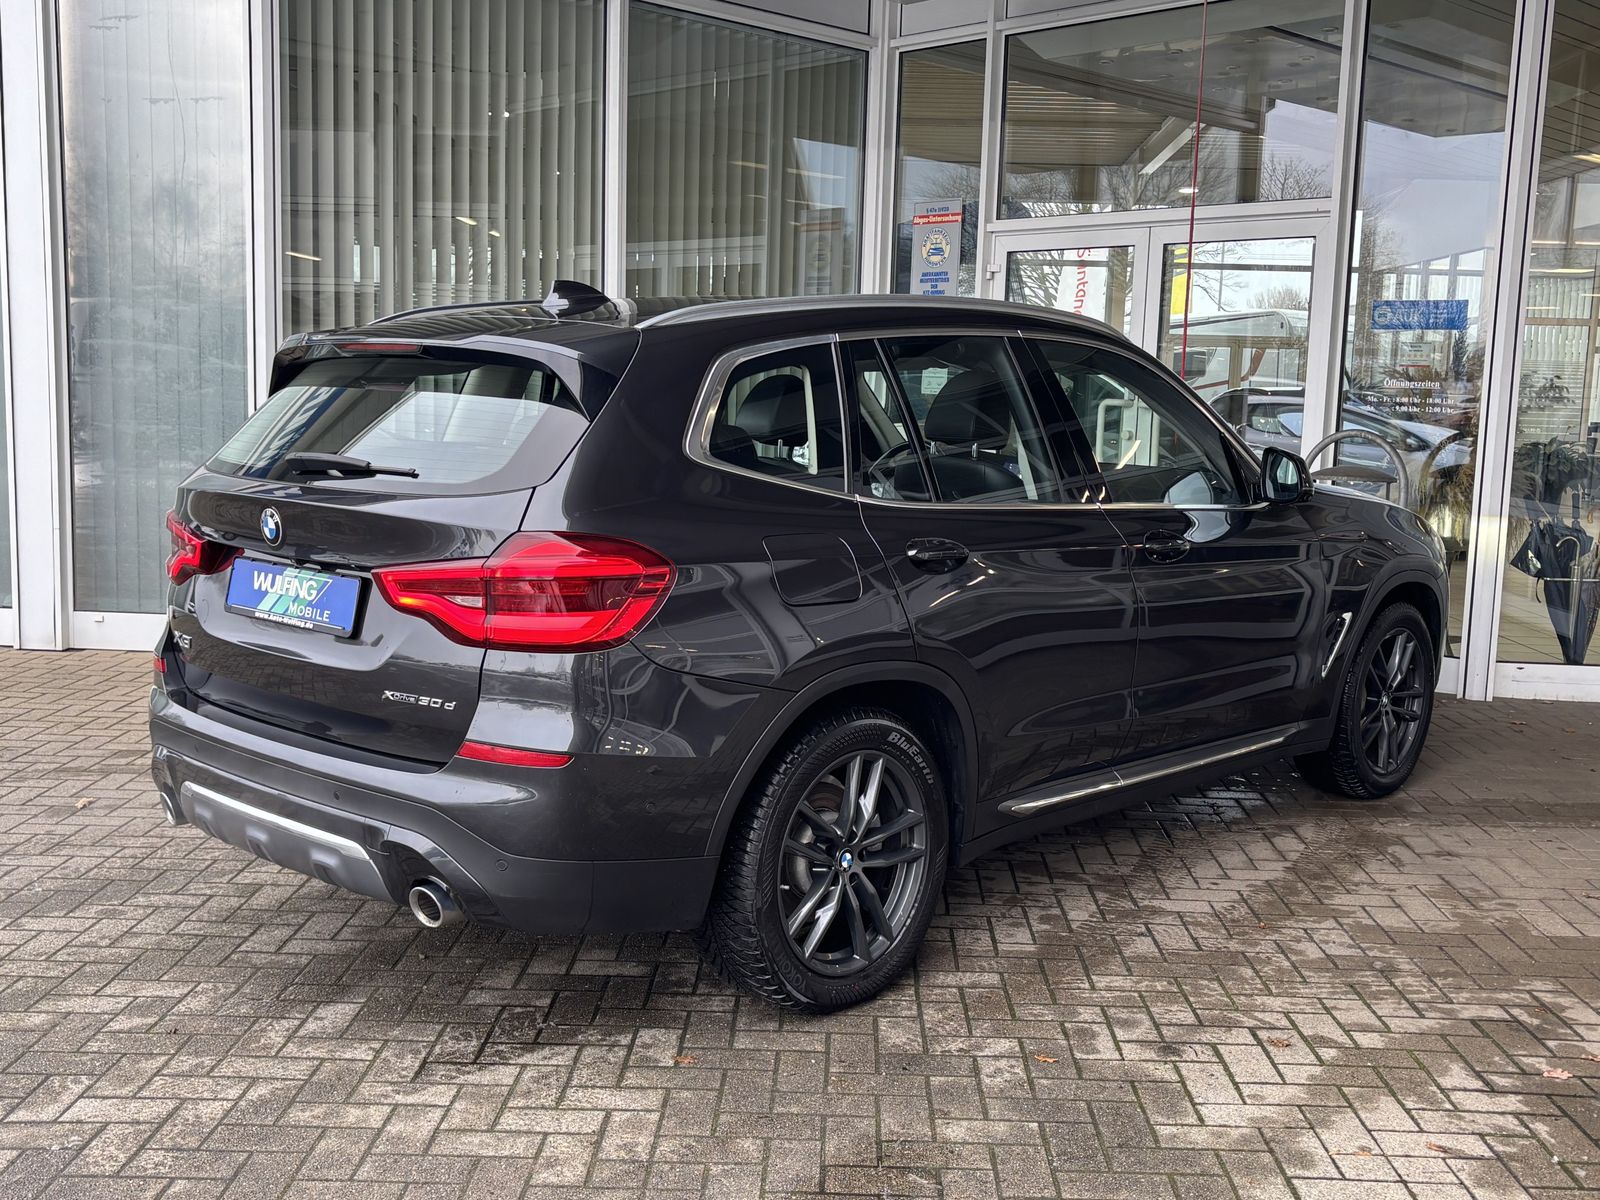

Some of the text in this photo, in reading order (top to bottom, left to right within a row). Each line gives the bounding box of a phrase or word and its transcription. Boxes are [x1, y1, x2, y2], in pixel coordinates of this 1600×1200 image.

[1383, 377, 1440, 389] Öffnungszeiten
[287, 601, 331, 622] MOBILE
[887, 731, 934, 784] BluEarth
